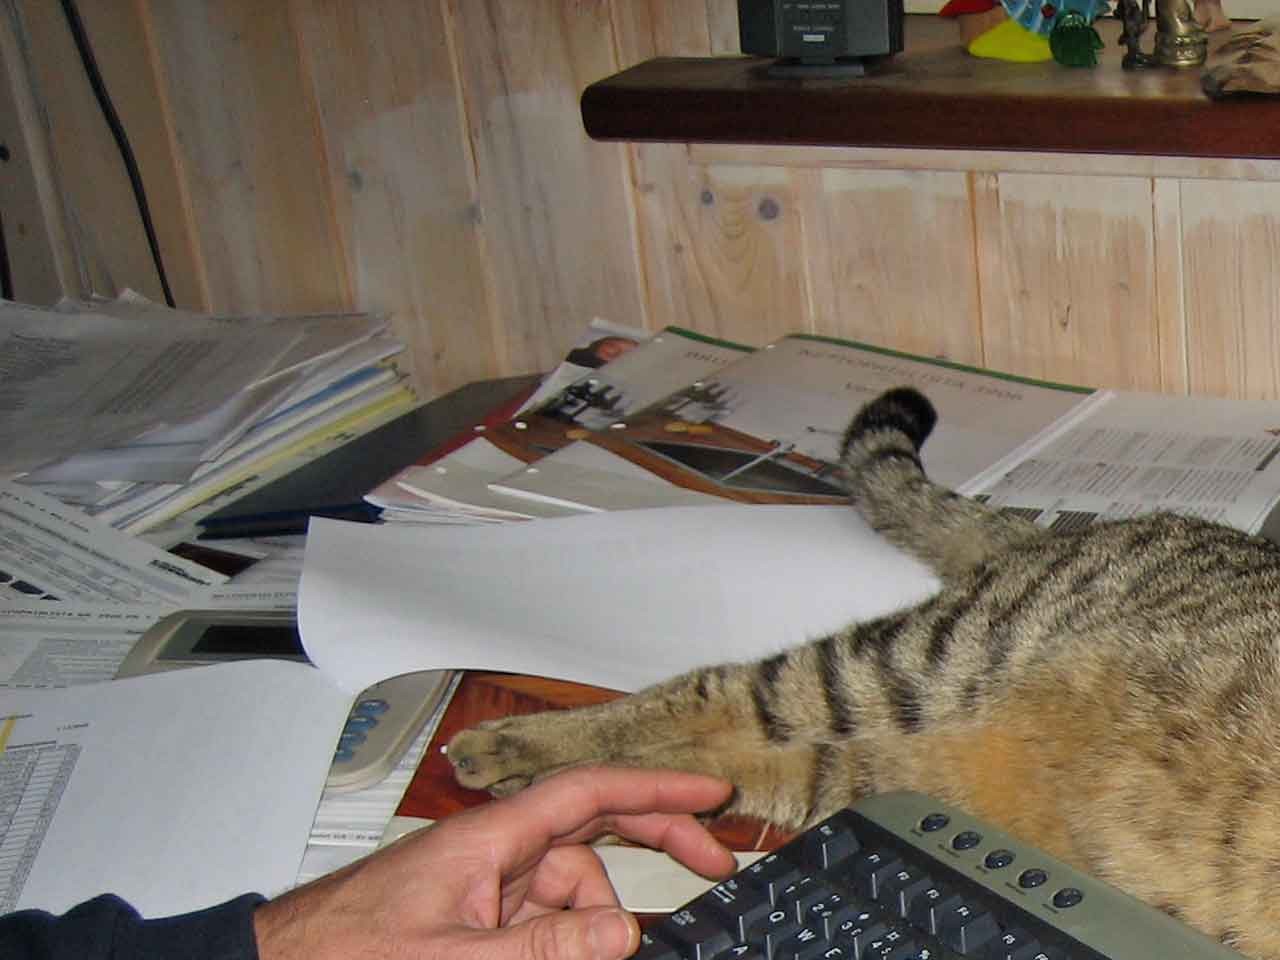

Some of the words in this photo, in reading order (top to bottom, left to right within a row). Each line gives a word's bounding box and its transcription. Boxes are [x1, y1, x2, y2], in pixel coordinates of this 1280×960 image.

[812, 903, 825, 912] 2
[841, 921, 853, 931] 3
[798, 929, 816, 942] W
[871, 940, 884, 949] 4
[732, 945, 748, 956] A
[825, 948, 842, 959] E
